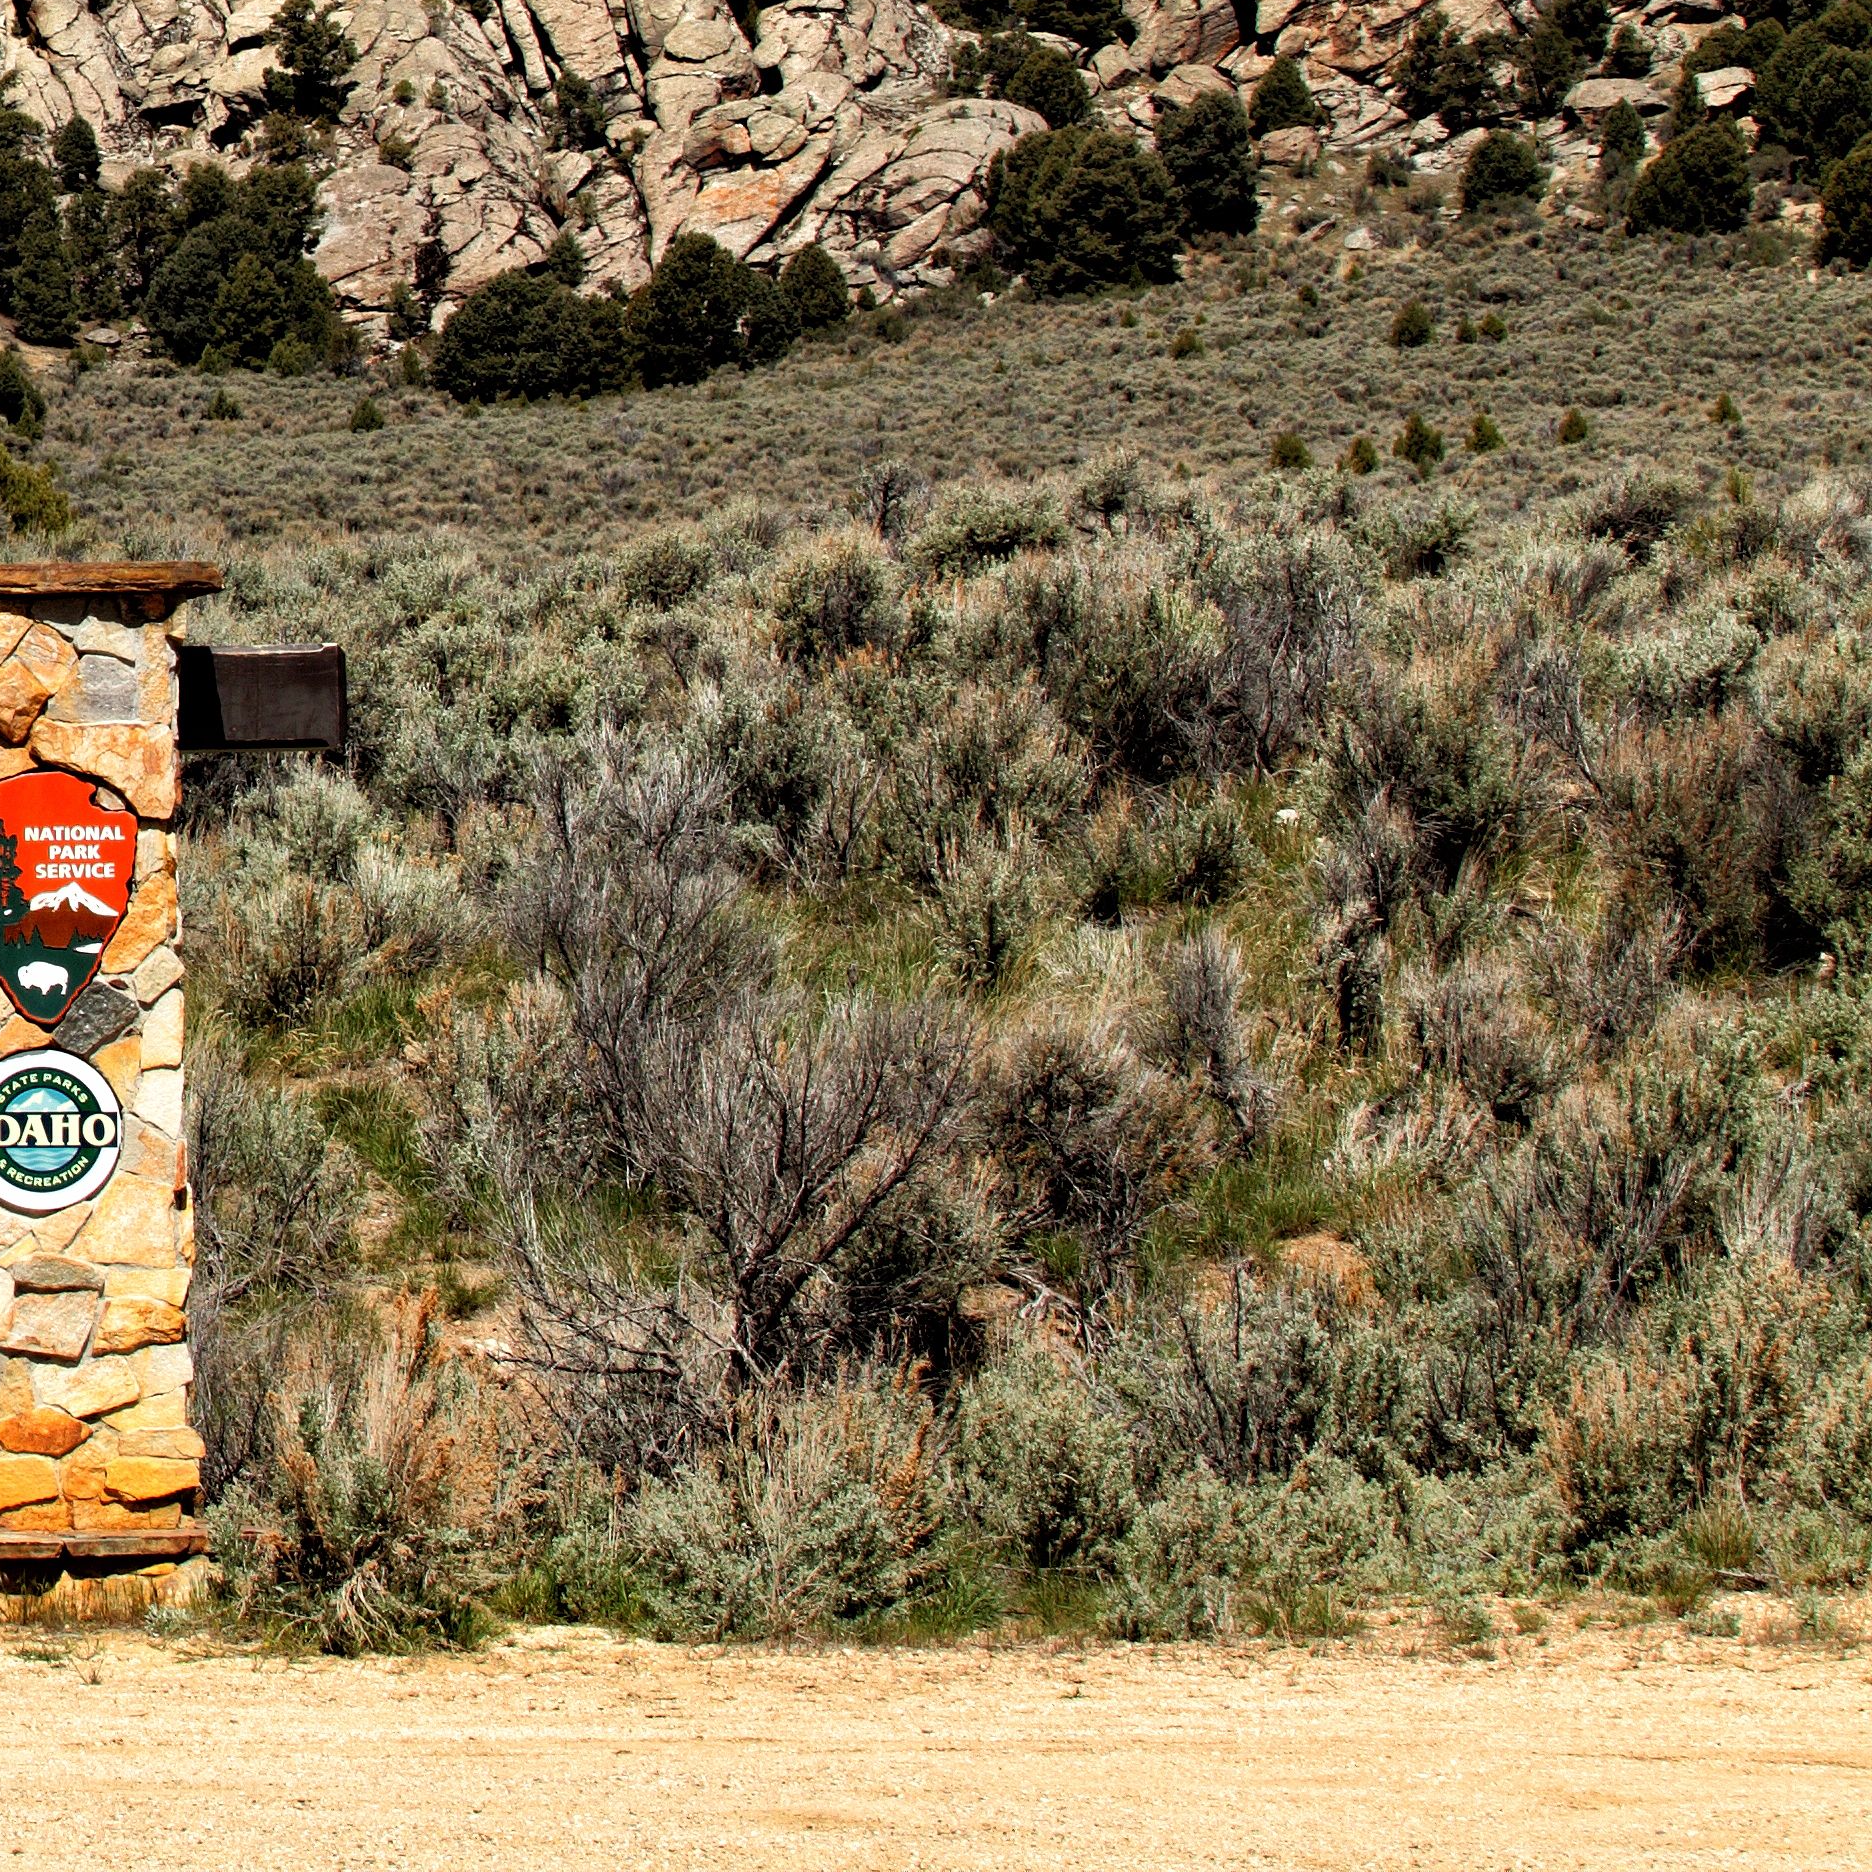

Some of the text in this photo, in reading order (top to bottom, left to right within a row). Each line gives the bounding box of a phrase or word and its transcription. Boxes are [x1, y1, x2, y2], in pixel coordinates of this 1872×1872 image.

[24, 824, 126, 842] NATIONAL
[48, 844, 101, 860] PARK
[35, 862, 115, 879] SERVICE
[42, 1073, 89, 1104] PARKS
[6, 1156, 90, 1187] RECREATION
